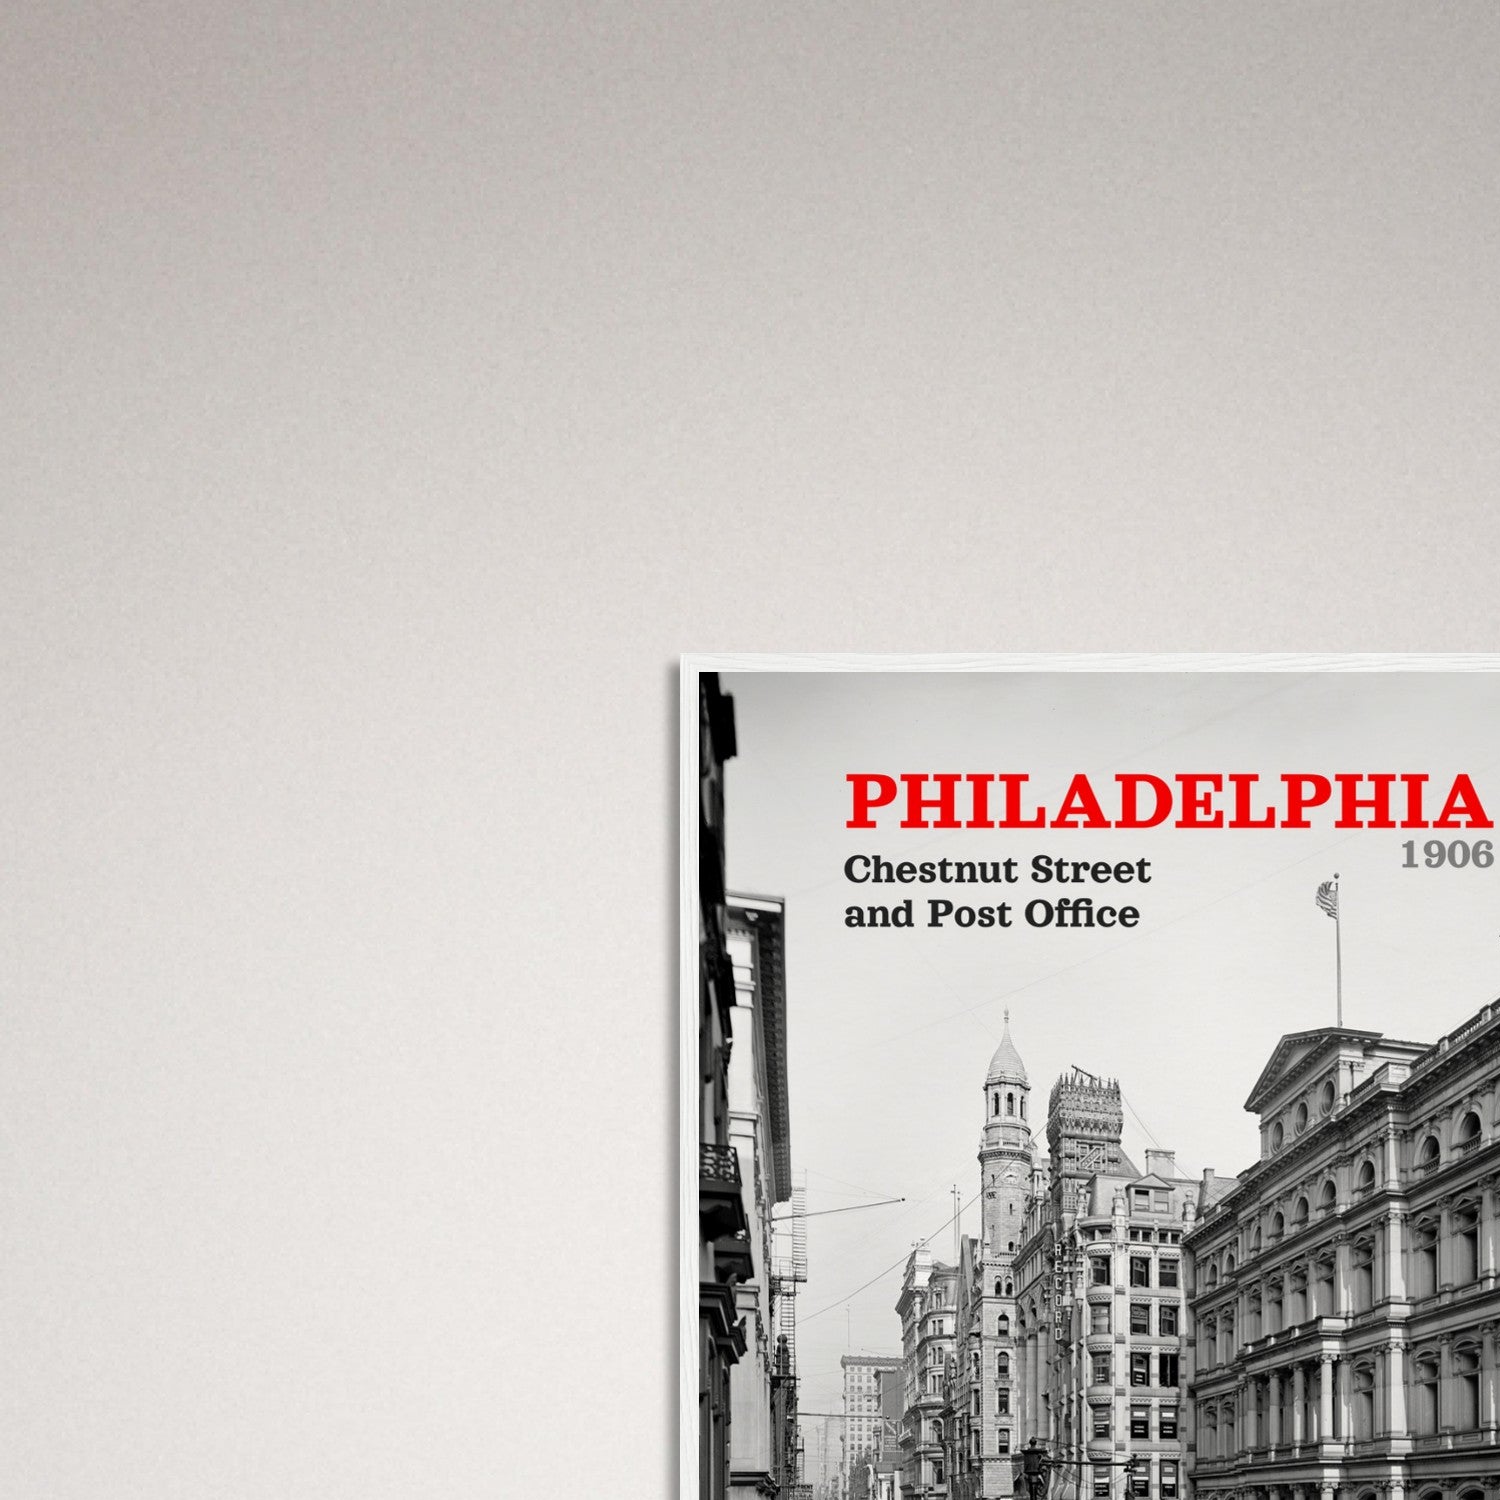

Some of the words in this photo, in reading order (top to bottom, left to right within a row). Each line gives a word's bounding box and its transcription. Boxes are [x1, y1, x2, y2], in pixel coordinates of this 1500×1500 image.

[845, 773, 1494, 829] PHILADELPHIA
[844, 855, 1018, 883] Chestnut
[1031, 855, 1152, 883] Street
[1402, 840, 1495, 869] 1906
[844, 899, 914, 928] and
[927, 899, 1012, 928] Post
[1025, 898, 1140, 928] Office
